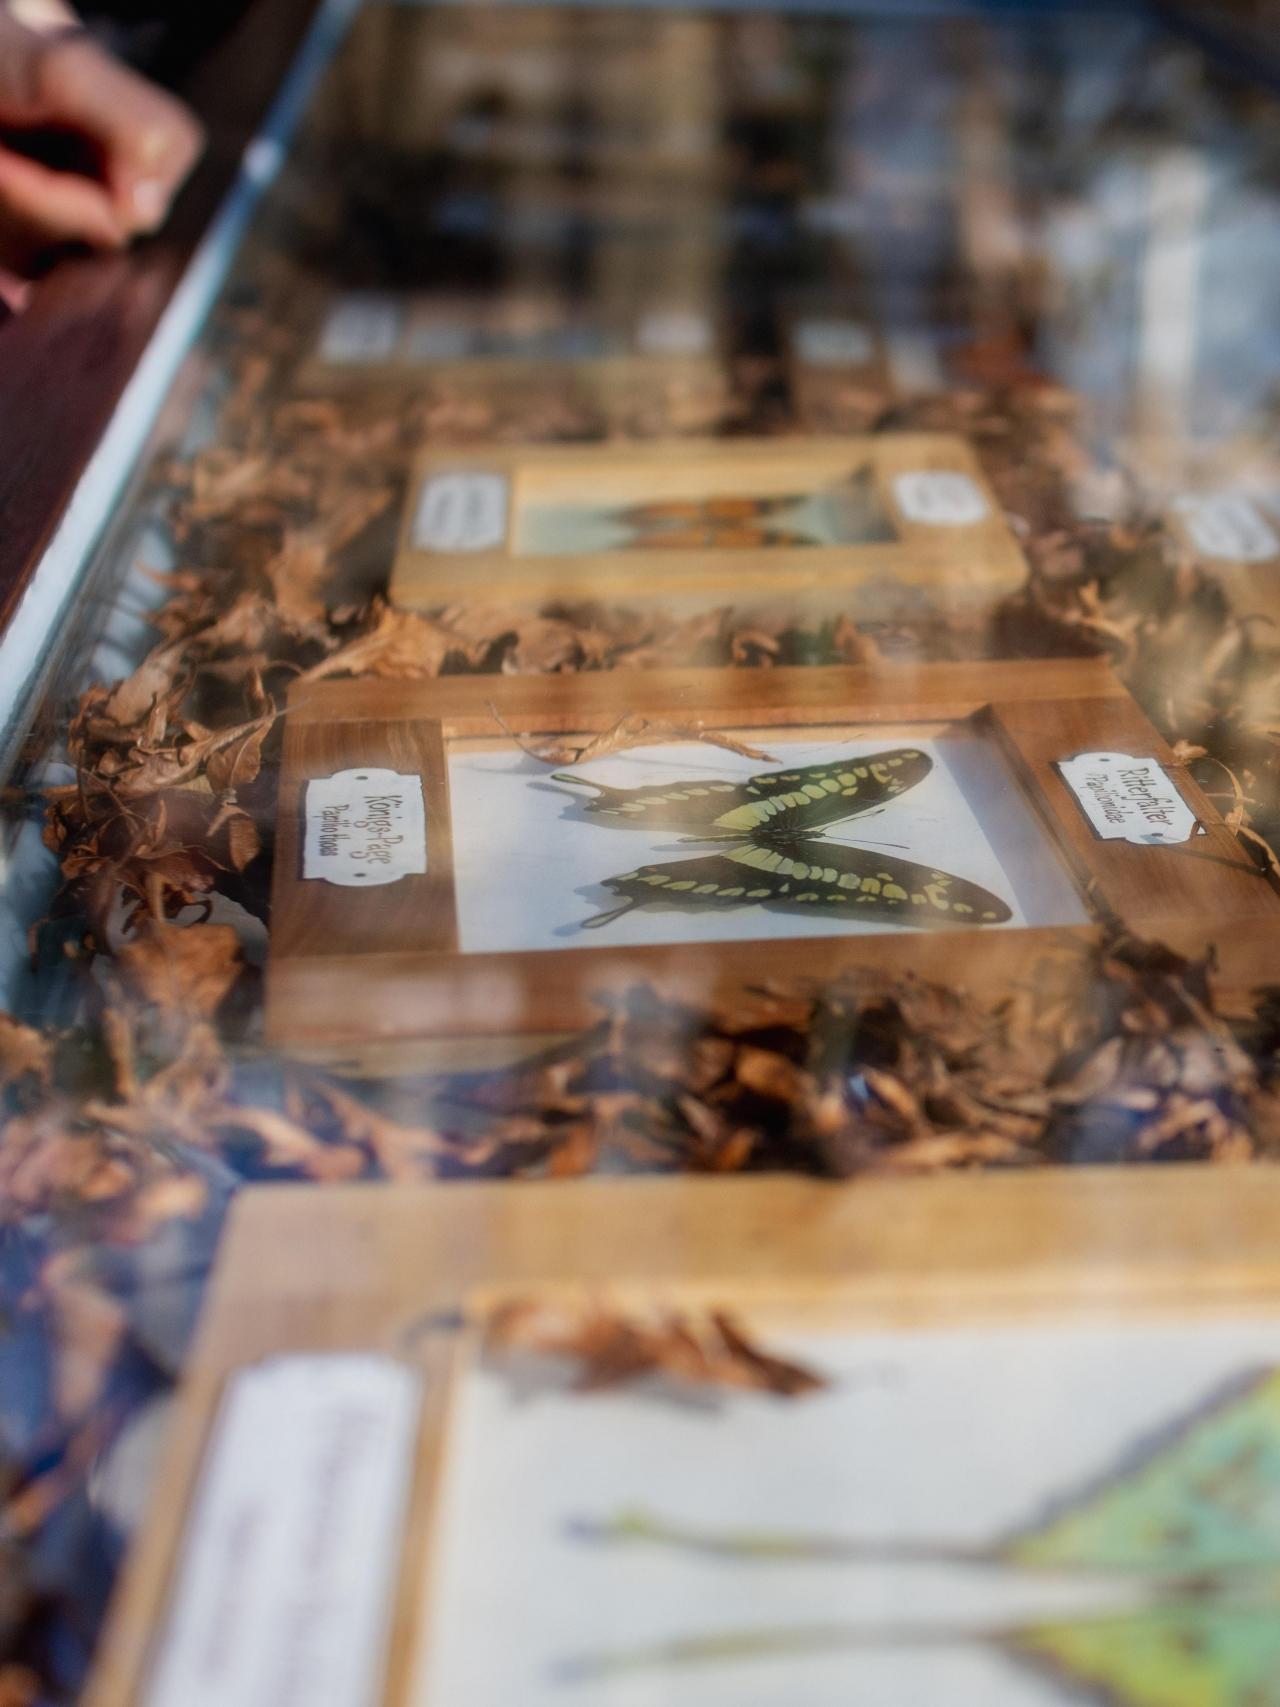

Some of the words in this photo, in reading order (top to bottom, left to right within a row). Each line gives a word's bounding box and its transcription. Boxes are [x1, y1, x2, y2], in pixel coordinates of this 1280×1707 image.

[312, 803, 351, 833] Papilio
[1117, 767, 1176, 826] Ritterfalter
[350, 795, 404, 865] Königs-Page
